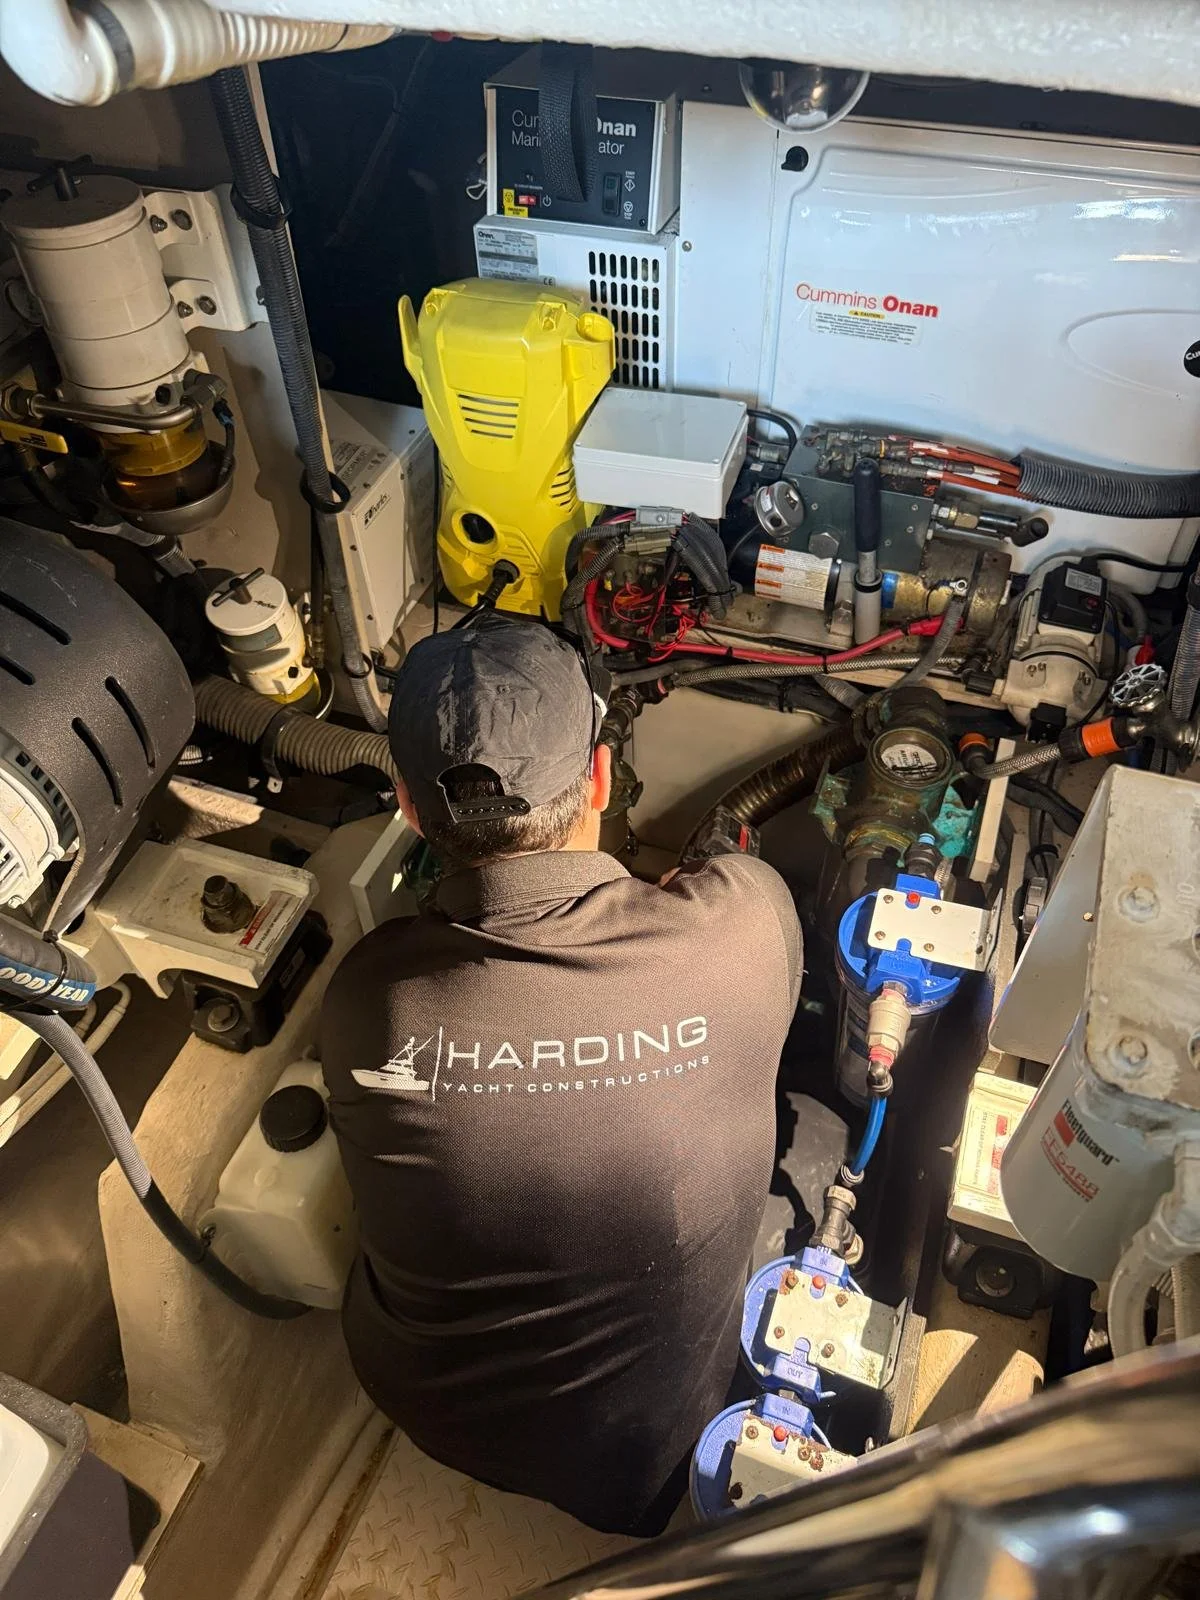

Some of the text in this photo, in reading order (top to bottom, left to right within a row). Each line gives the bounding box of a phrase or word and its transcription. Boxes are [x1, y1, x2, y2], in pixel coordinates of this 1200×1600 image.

[796, 283, 939, 317] Cummins Onan
[0, 967, 89, 1001] OODYEAR
[447, 1015, 708, 1070] HARDING
[443, 1055, 711, 1094] YACHT CONSTRUCTIONS
